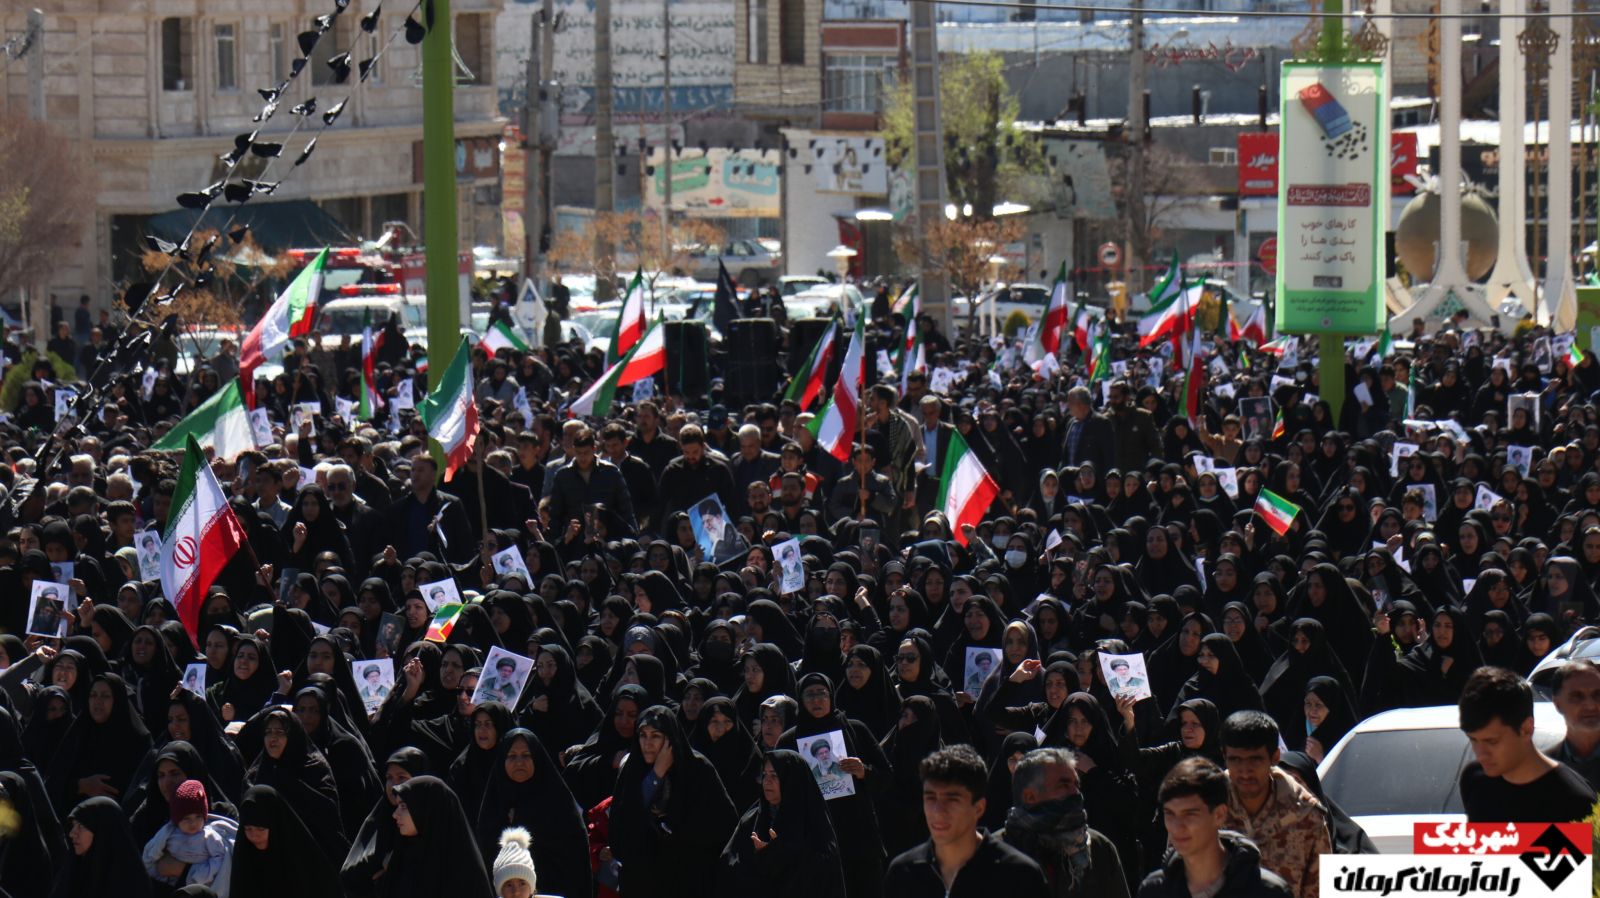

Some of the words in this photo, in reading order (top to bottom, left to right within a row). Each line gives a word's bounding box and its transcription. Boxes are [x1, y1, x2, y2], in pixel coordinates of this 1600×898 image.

[1301, 221, 1322, 232] خوب
[1324, 218, 1357, 232] کارهای
[1301, 234, 1308, 247] را
[1310, 234, 1327, 244] ها
[1323, 255, 1338, 264] می
[1339, 251, 1356, 265] پاک
